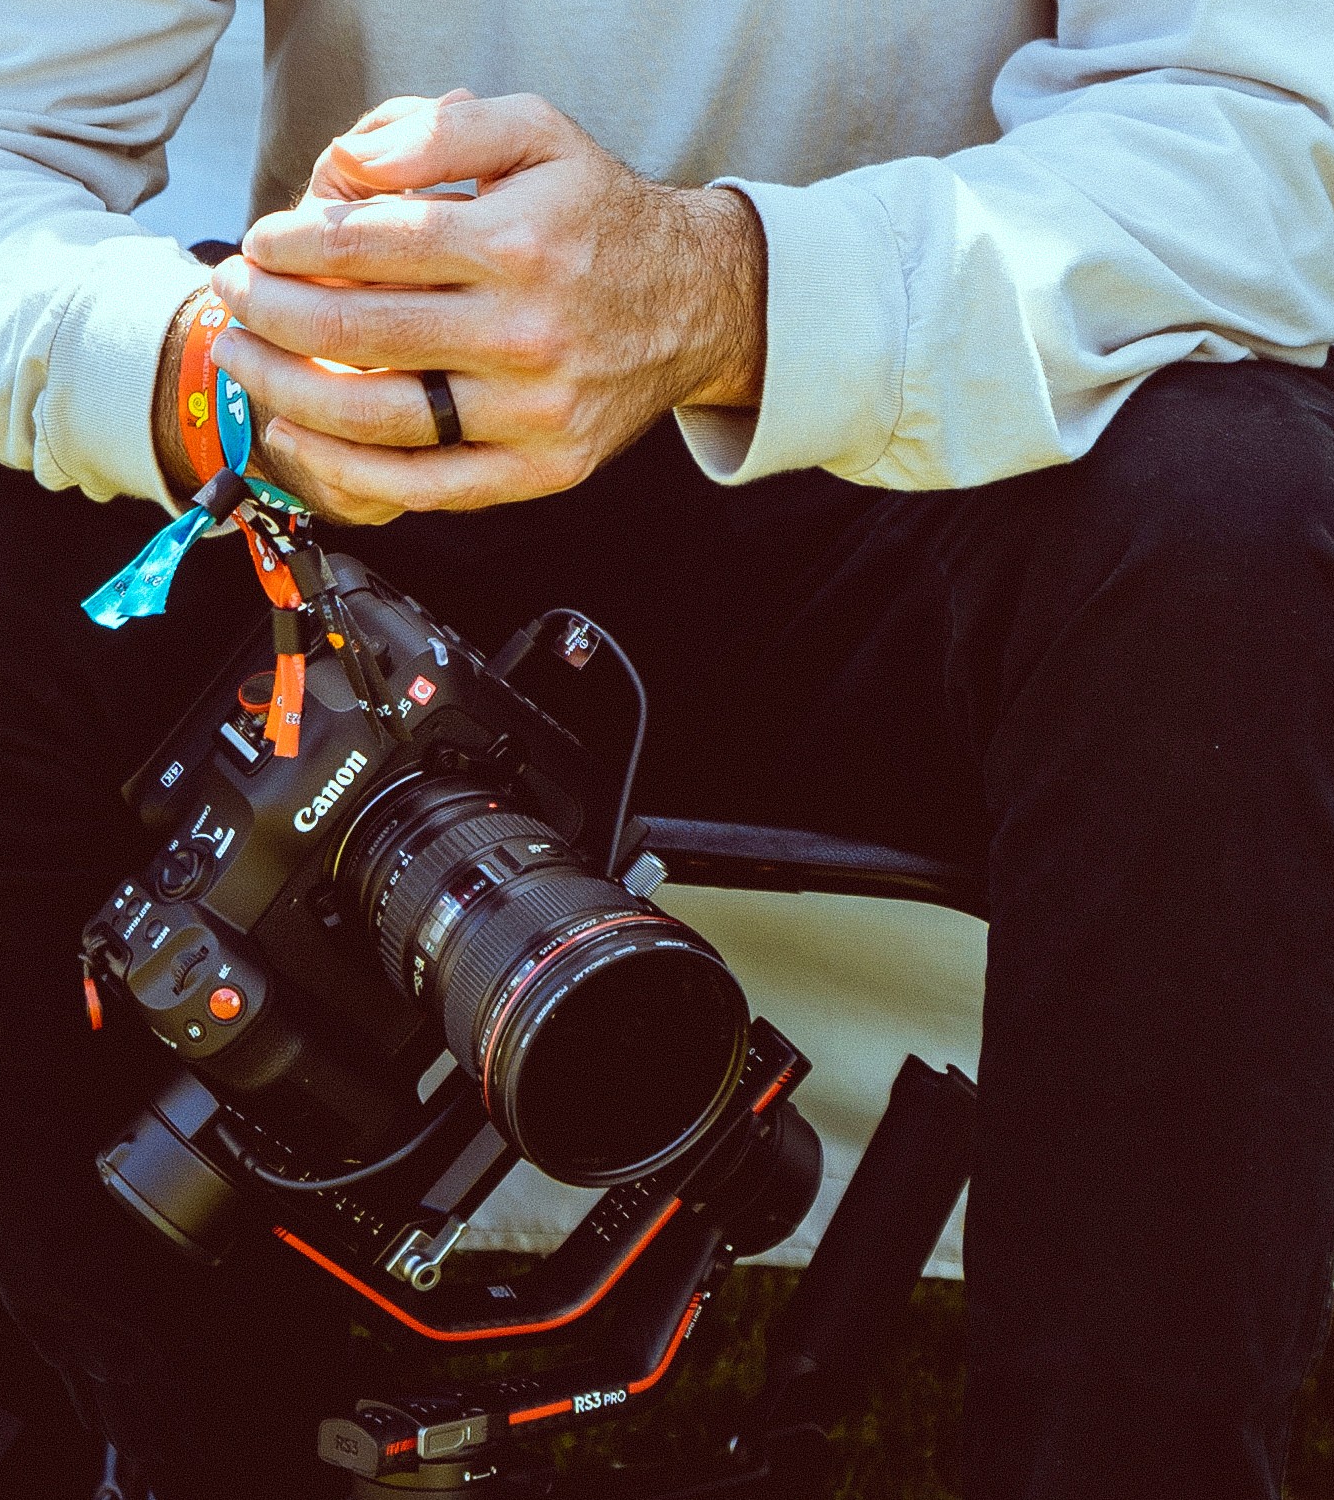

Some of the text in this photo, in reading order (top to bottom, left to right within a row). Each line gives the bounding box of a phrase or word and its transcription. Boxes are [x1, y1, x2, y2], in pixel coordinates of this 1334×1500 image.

[225, 378, 244, 426] IP
[163, 764, 181, 786] 4K
[293, 750, 368, 833] Canon
[566, 918, 599, 937] ZOOM
[573, 1389, 627, 1414] RS3 PRO
[334, 1434, 360, 1456] RS3
